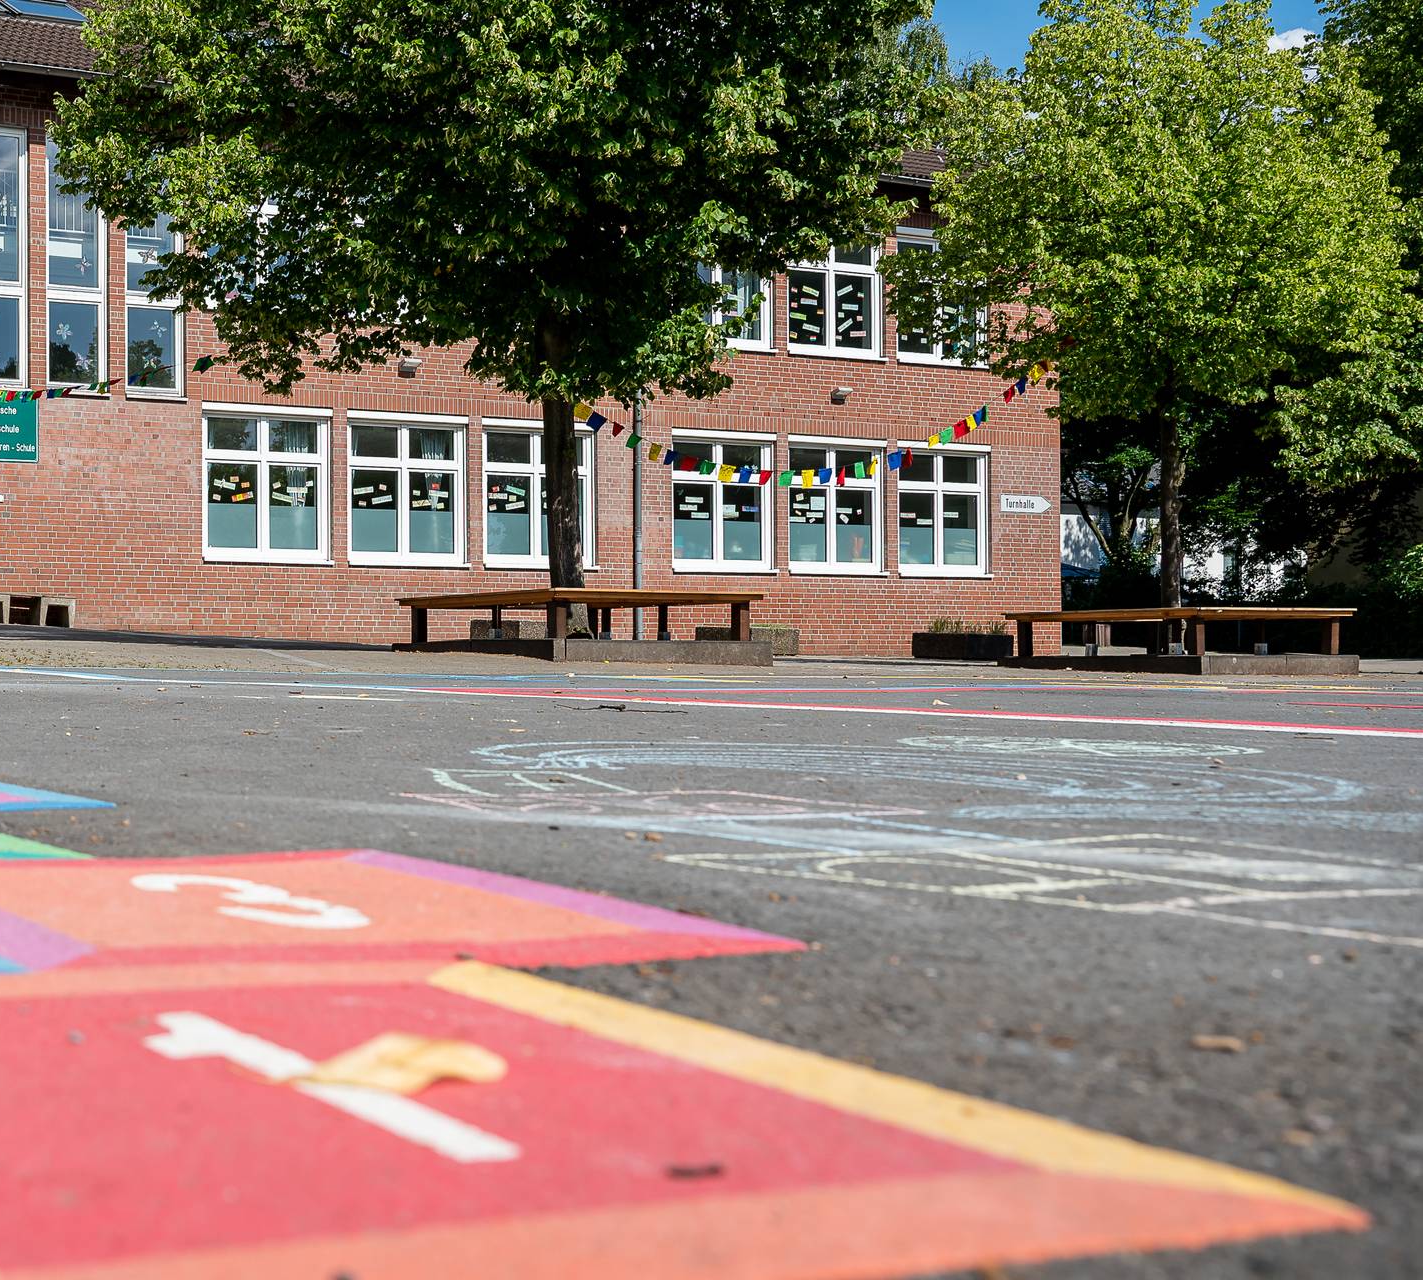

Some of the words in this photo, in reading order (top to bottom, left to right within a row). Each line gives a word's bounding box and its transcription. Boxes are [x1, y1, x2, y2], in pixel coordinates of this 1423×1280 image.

[16, 443, 36, 453] Schule
[1006, 498, 1035, 509] Turnhalle
[130, 872, 372, 930] 3
[144, 1011, 522, 1163] 1
